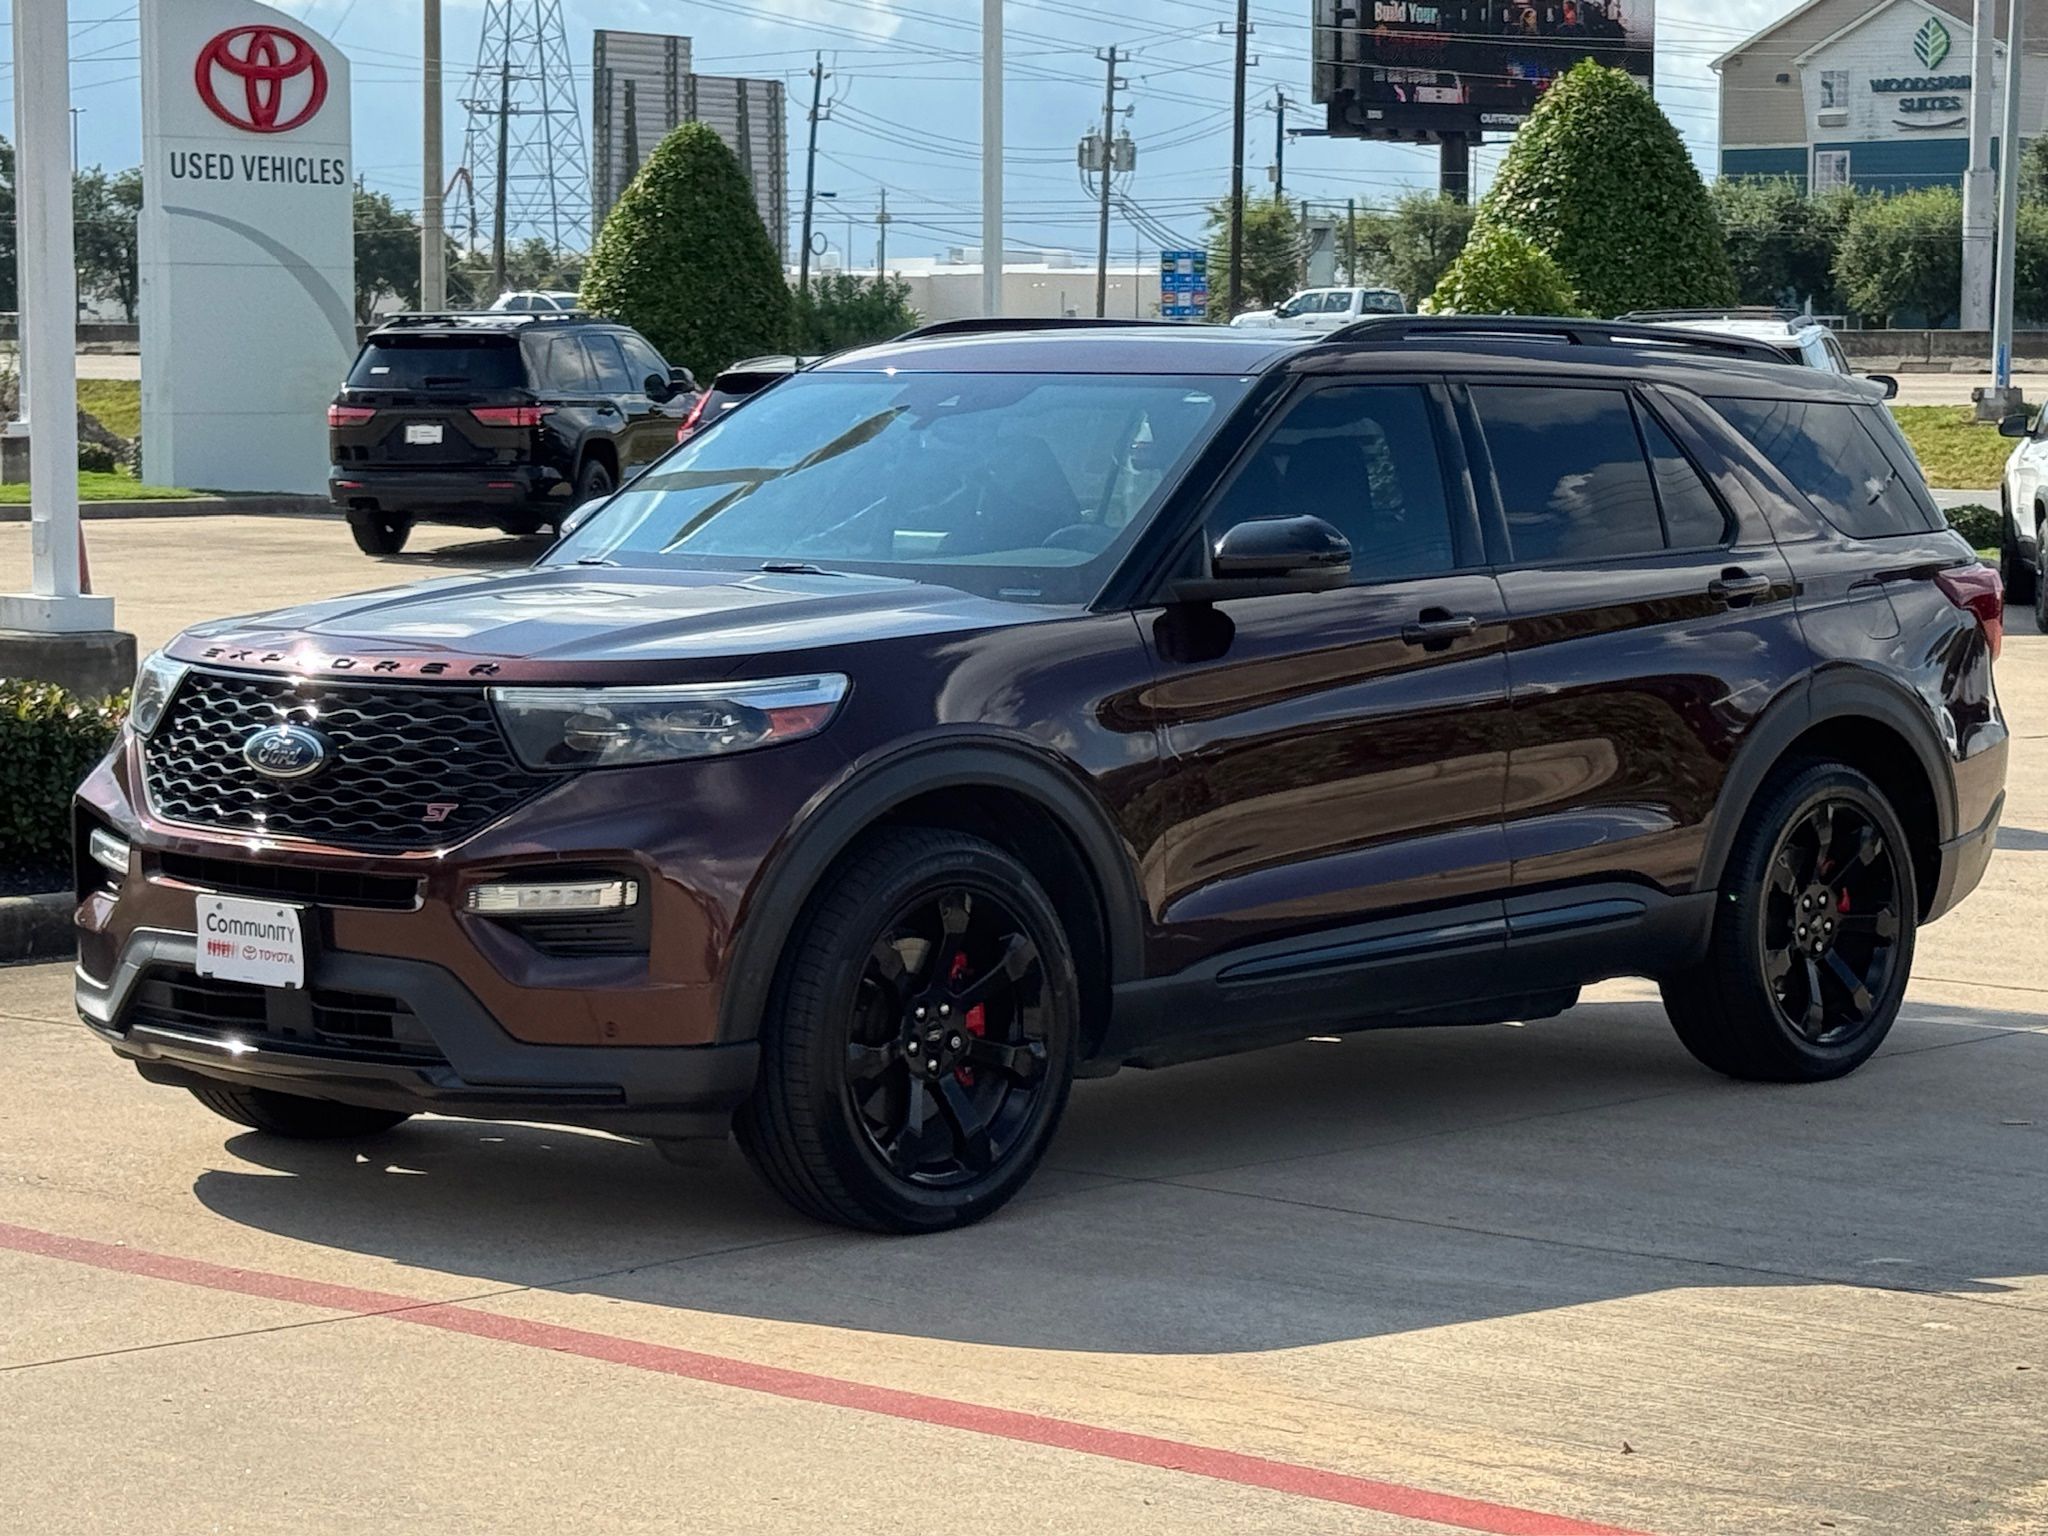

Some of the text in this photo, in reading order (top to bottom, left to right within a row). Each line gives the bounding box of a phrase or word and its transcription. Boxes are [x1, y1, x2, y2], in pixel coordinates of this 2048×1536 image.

[1374, 1, 1438, 24] Build Your
[1869, 75, 1972, 92] WOODSPRIN
[1899, 96, 1962, 113] SUITES
[170, 152, 345, 185] USED VEHICLES
[201, 647, 501, 677] EXPORER
[258, 736, 303, 765] Ford
[422, 803, 459, 821] ST
[259, 949, 295, 964] TOYOTA
